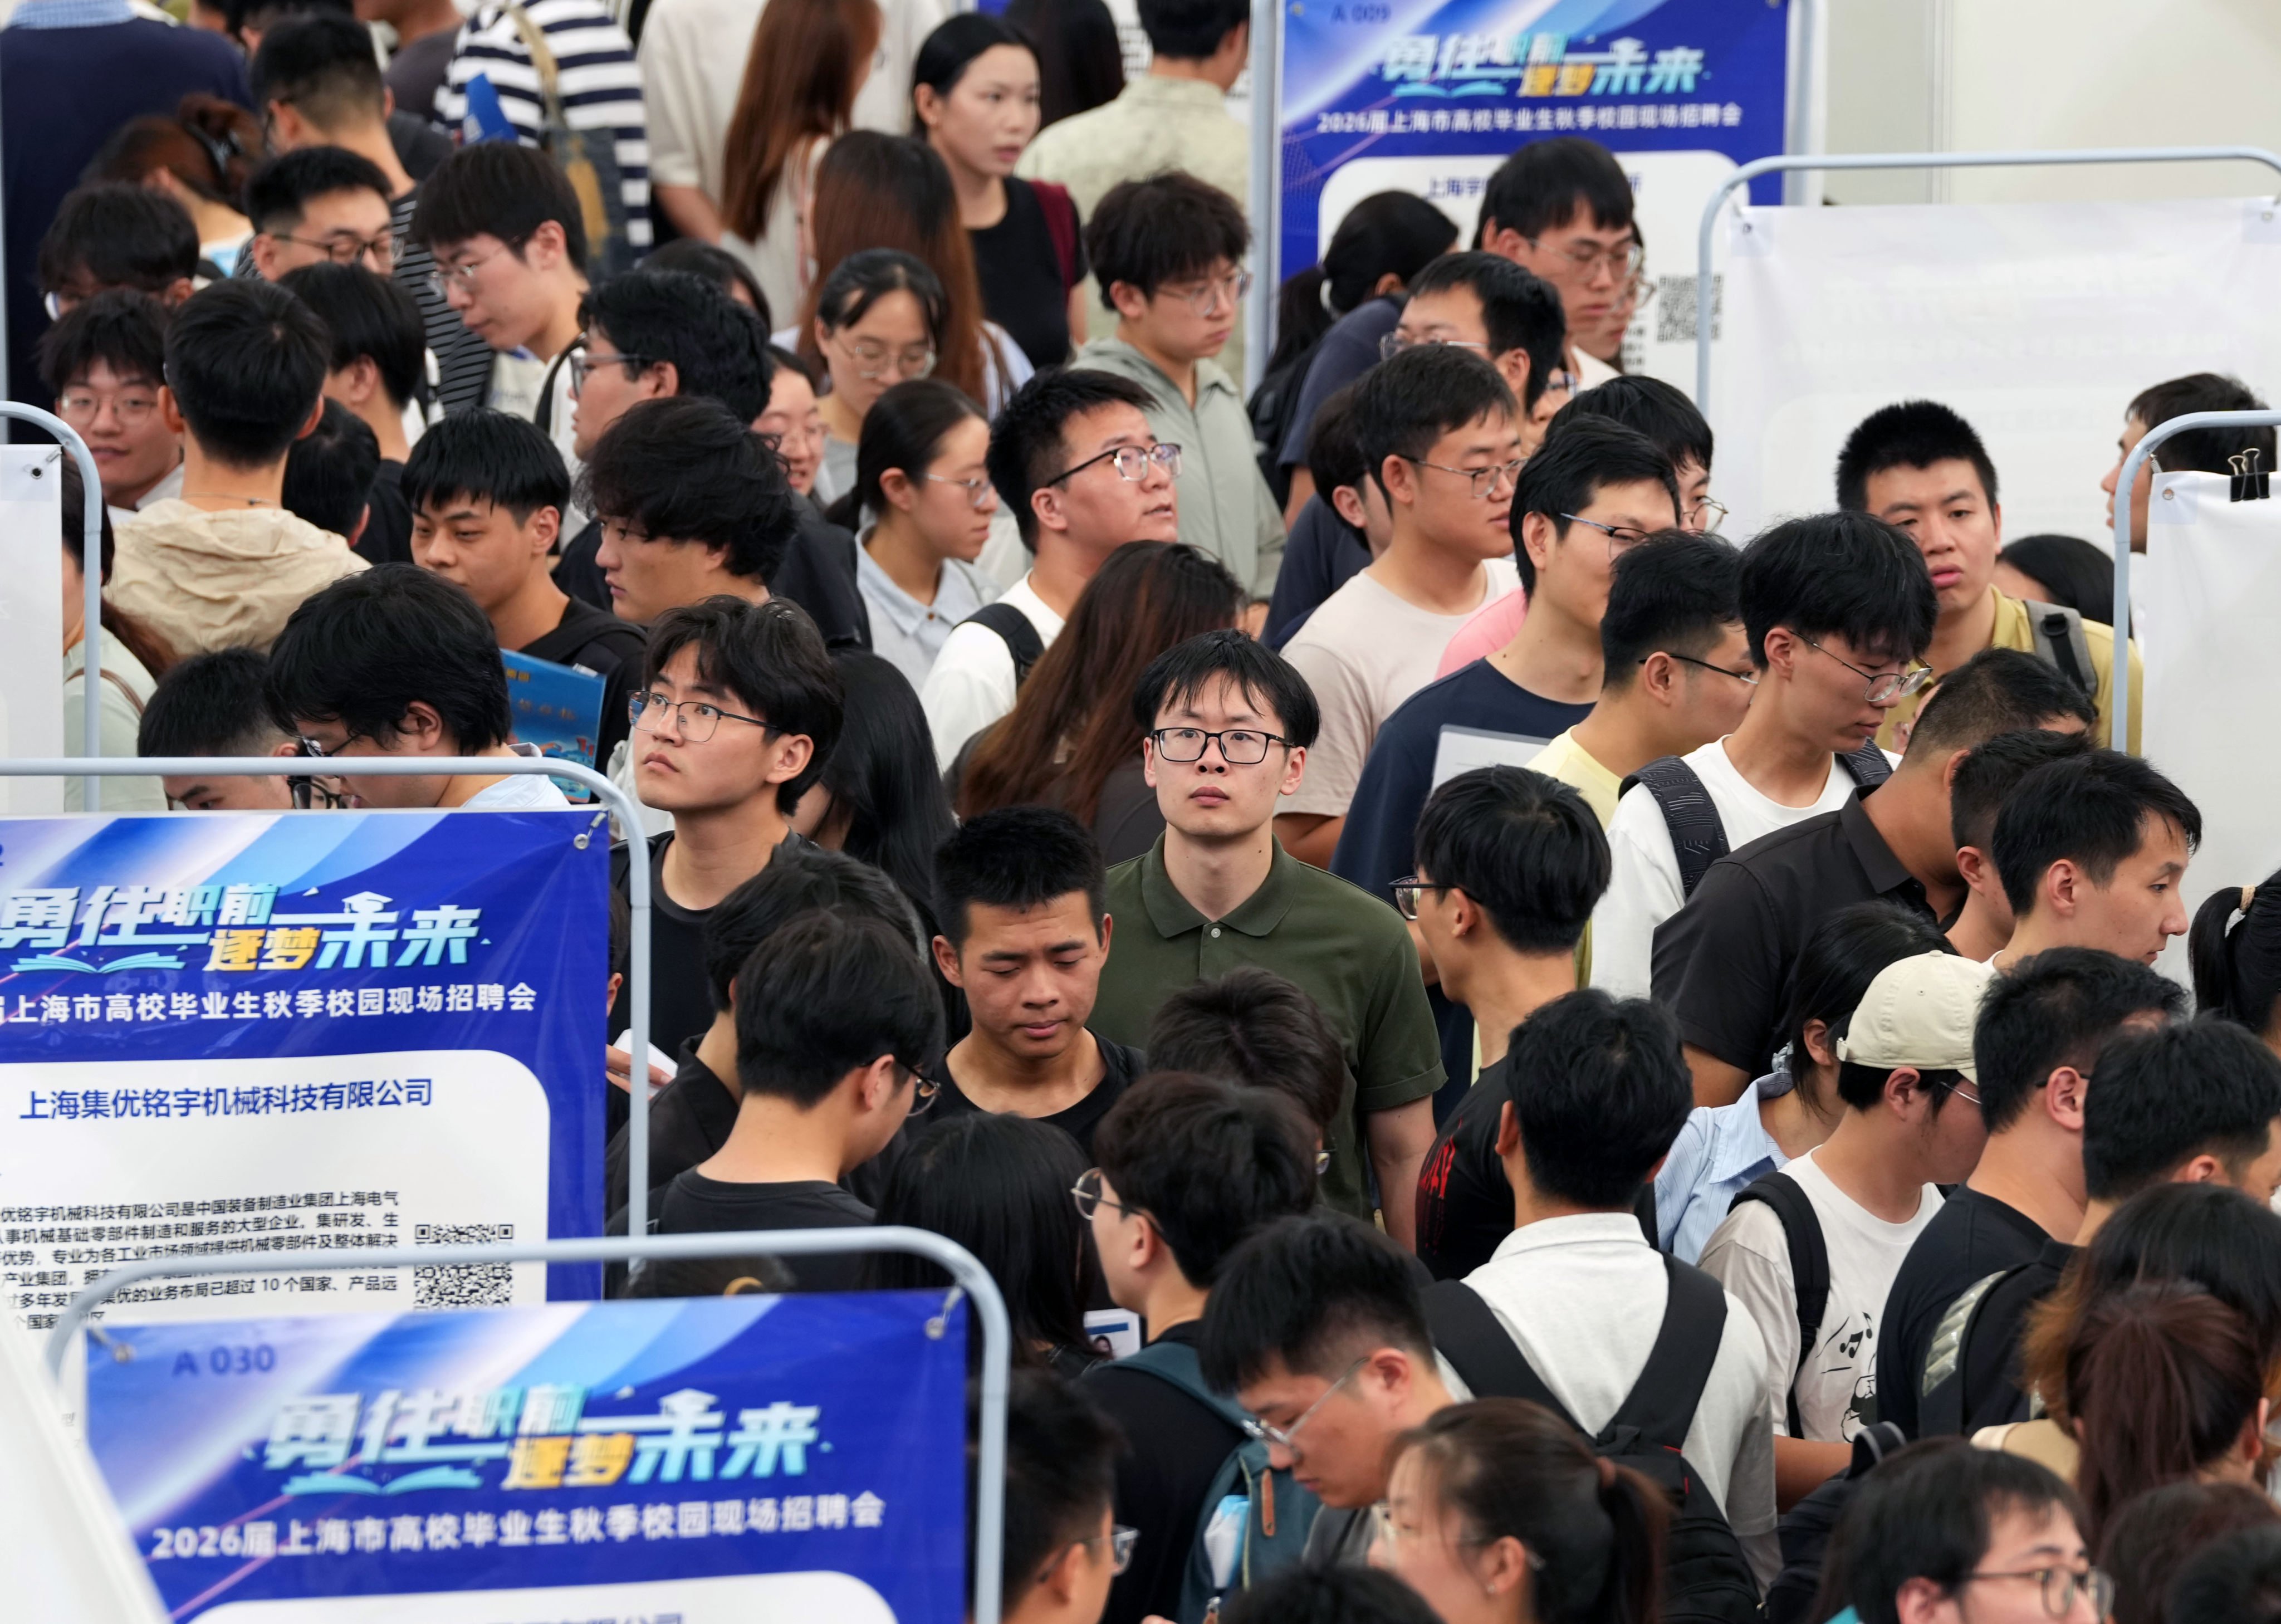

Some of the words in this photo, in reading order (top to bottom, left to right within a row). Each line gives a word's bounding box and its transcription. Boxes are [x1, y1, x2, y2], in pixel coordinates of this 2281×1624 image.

[0, 982, 537, 1023] 上海市高校毕业生秋季校园现场招聘会
[19, 1078, 433, 1120] 上海集优铭宇机械科技有限公司
[0, 1212, 398, 1244] 事机械基础零部件制造和服务的大型企业。集研发、生
[262, 1279, 279, 1292] 10
[172, 1351, 198, 1377] A
[210, 1345, 275, 1375] 030
[152, 1490, 886, 1559] 2026届上海市高校毕业生秋季校园现场招聘会
